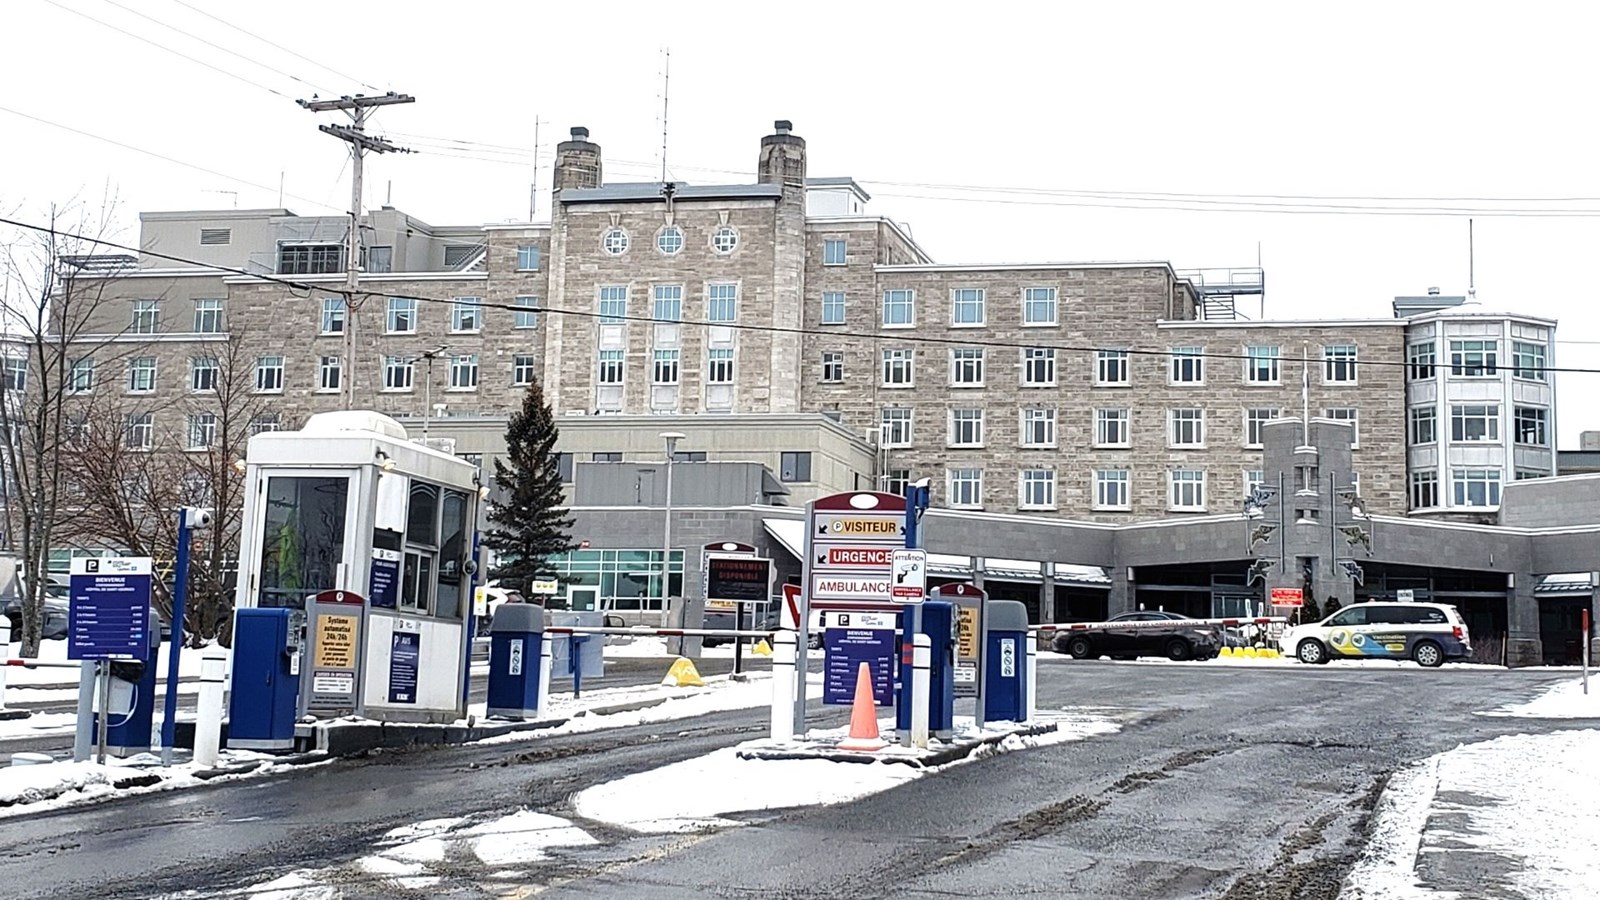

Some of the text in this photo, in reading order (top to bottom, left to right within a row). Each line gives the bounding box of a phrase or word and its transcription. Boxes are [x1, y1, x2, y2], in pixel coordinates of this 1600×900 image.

[844, 521, 897, 533] VISITEUR
[833, 551, 892, 562] URGENCE
[819, 581, 890, 593] AMBULANCE
